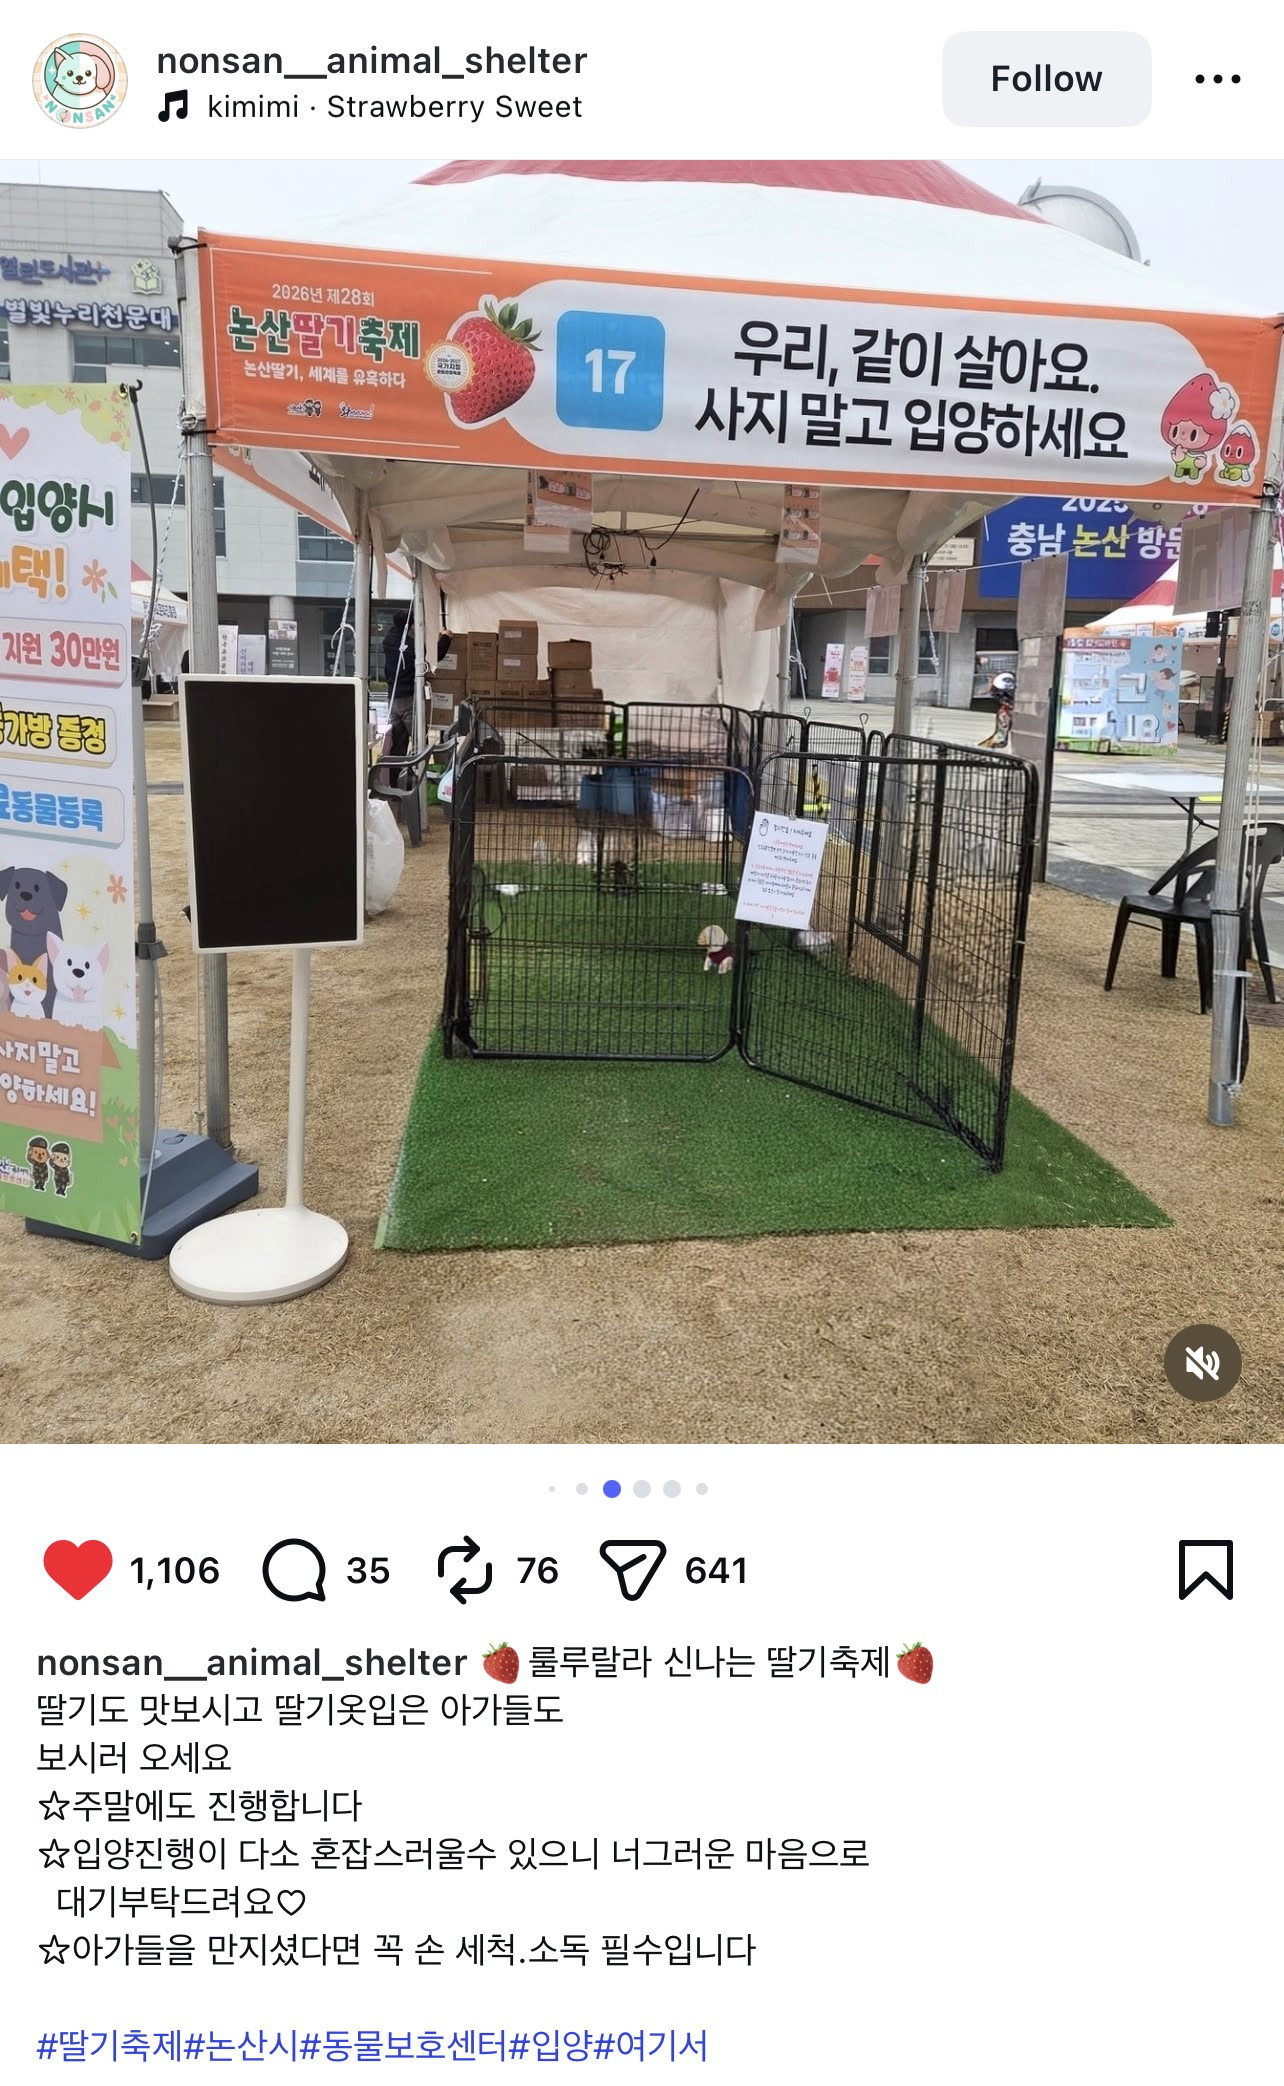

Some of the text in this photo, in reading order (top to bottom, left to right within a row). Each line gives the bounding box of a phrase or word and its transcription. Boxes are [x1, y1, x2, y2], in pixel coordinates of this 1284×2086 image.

[4, 298, 173, 332] 별빛누리천문대
[271, 283, 375, 308] 2026년 제28회
[228, 305, 421, 364] 논산딸기축제
[243, 359, 406, 389] 논산딸기, 세계를 유혹하다
[585, 348, 637, 395] 17
[734, 320, 1100, 393] 우리, 같이 살아요.
[695, 386, 1128, 460] 사지 말고 입양하세요
[0, 480, 114, 533] 입양시
[1007, 522, 1066, 557] 충남
[1072, 523, 1130, 558] 논산
[3, 630, 120, 671] 지원 30만원
[57, 714, 106, 755] 증정
